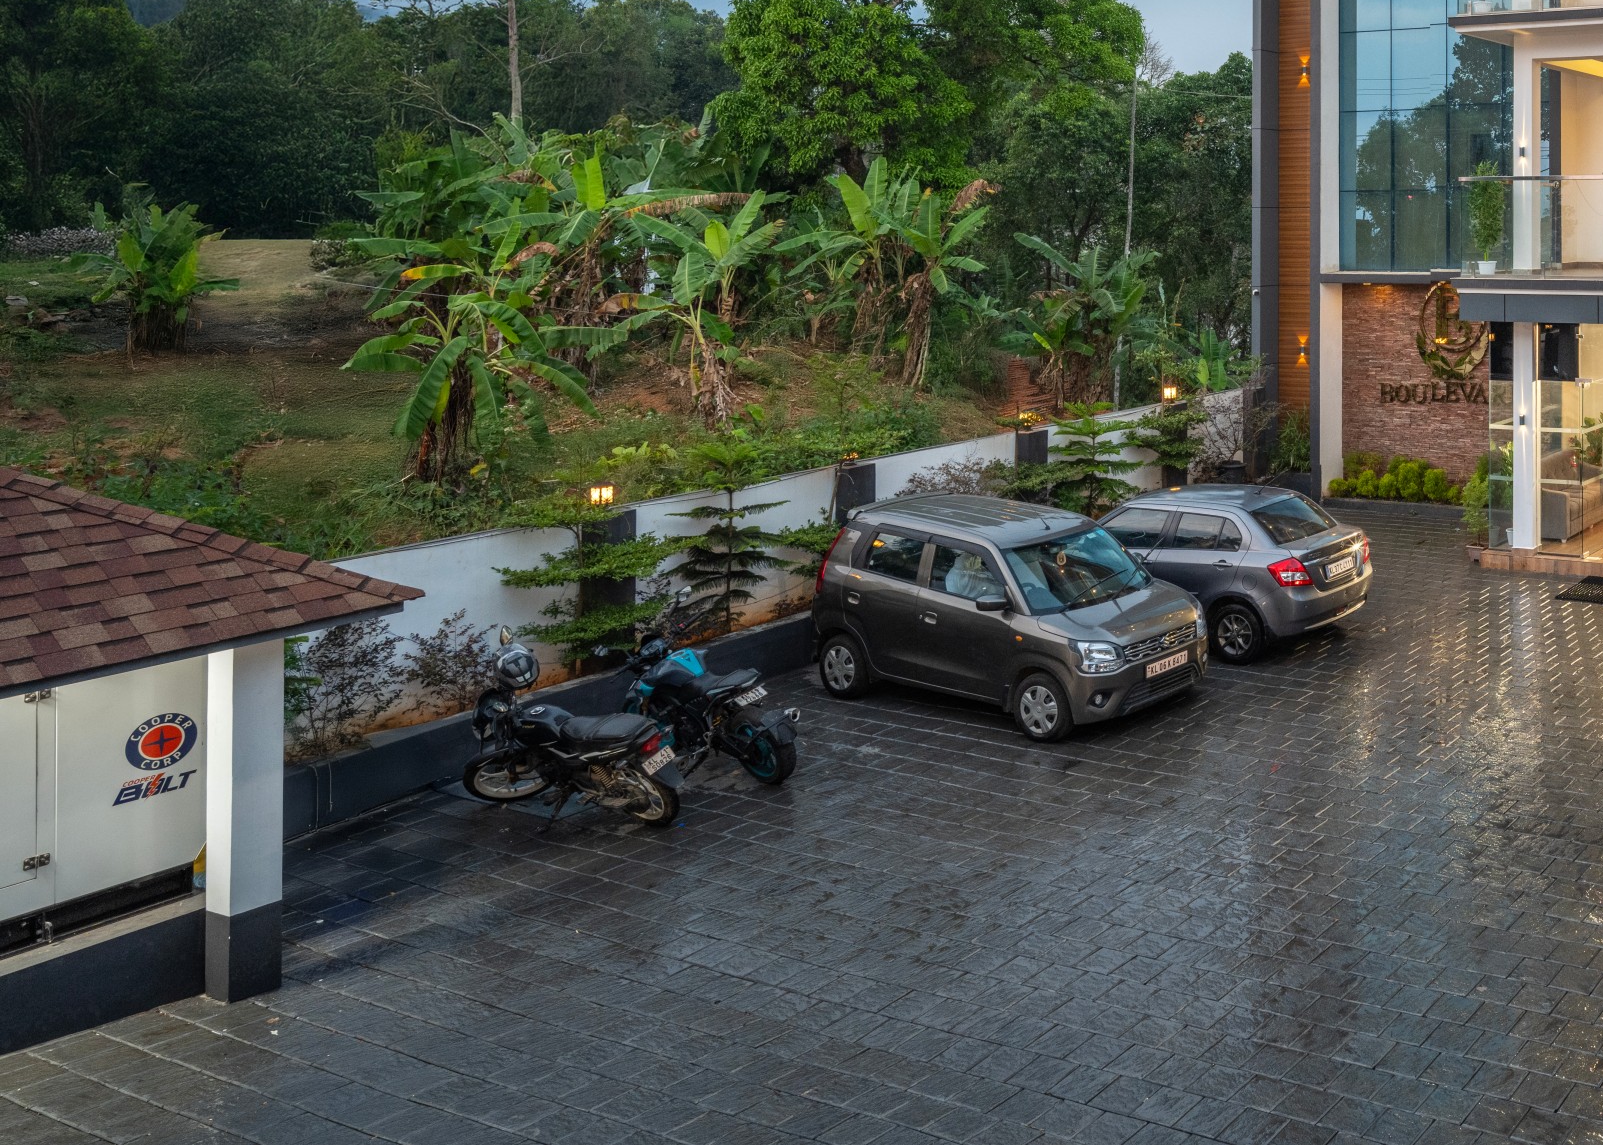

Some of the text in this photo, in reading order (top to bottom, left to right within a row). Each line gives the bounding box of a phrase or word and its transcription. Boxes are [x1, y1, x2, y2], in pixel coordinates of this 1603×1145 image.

[130, 713, 193, 741] COOPER
[140, 751, 182, 769] CORP
[112, 769, 198, 807] BOLT
[122, 775, 156, 788] COOPER
